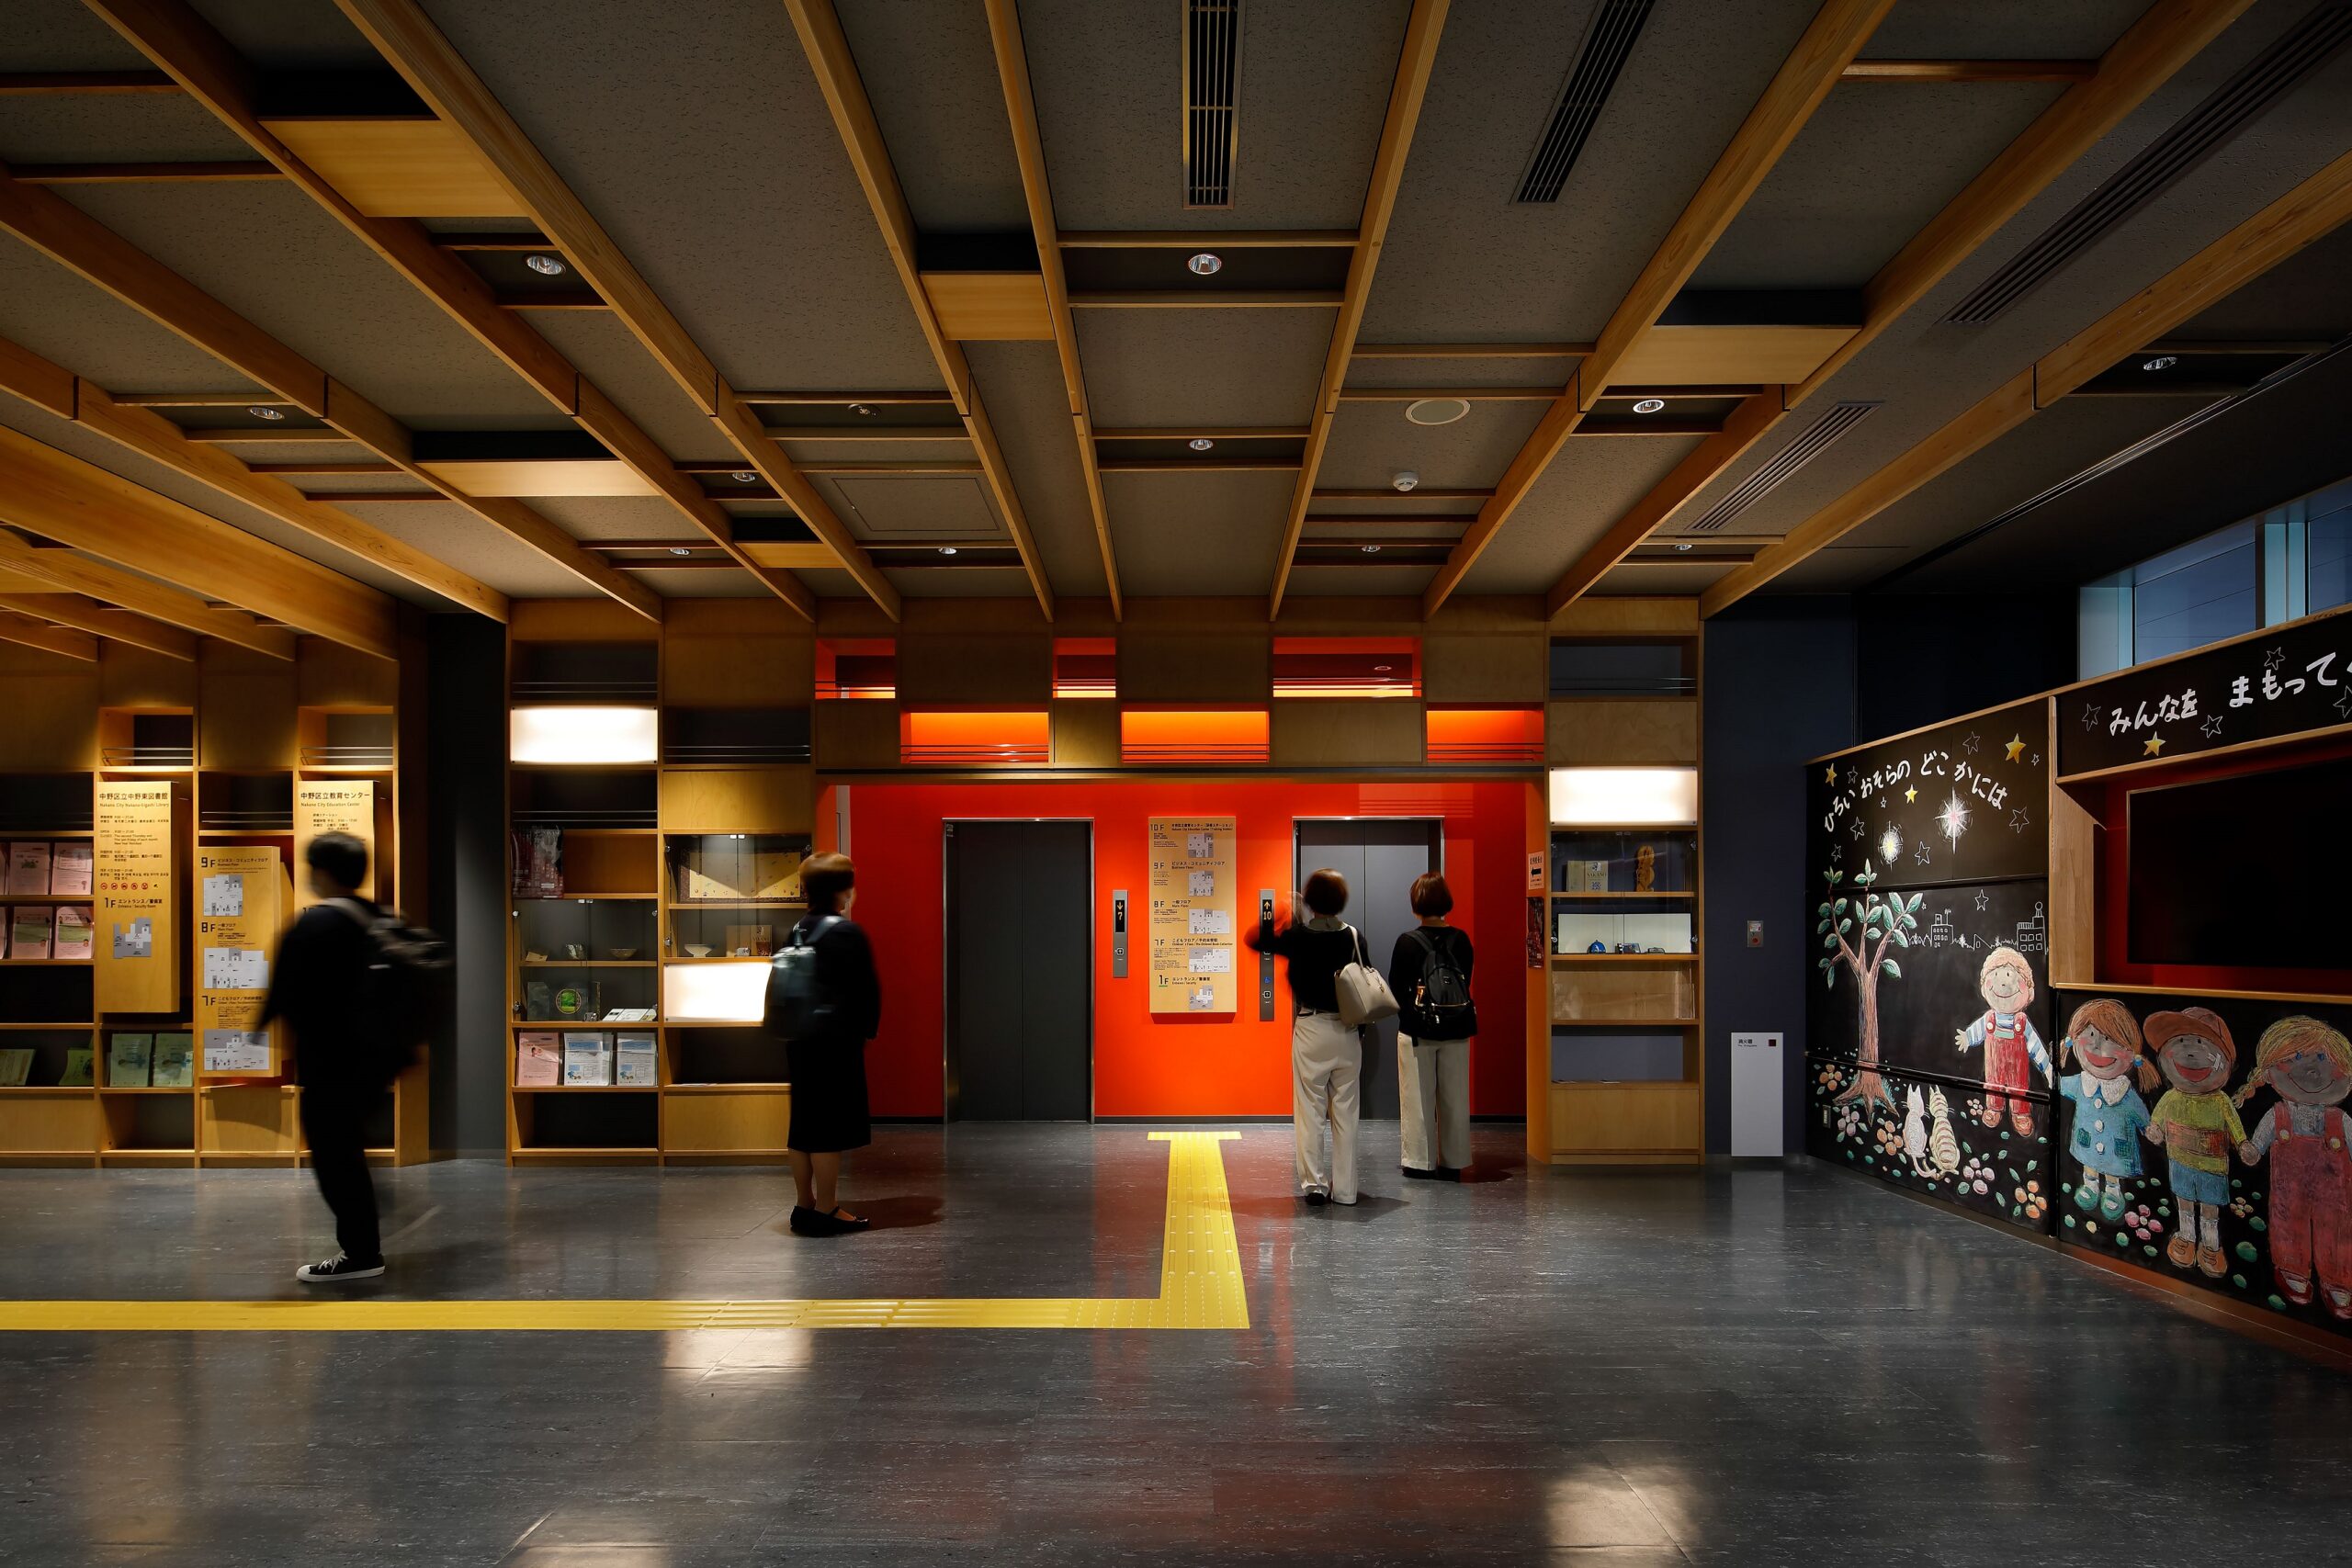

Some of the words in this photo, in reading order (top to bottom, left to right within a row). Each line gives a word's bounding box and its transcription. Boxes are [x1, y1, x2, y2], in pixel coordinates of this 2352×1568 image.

[2109, 689, 2198, 737] みんなを
[2228, 651, 2352, 707] まもって
[99, 792, 168, 800] 中野区立中野東図書館
[1824, 789, 1856, 832] ひろい
[1860, 760, 1911, 798] おそらの
[1920, 750, 1950, 776] どこ
[1953, 761, 2007, 810] かには
[1150, 823, 1165, 831] 10F
[201, 856, 216, 868] 9F
[105, 897, 117, 908] 1F
[1263, 910, 1272, 920] 10
[201, 921, 216, 932] 8F
[1159, 975, 1169, 985] 1F
[201, 995, 216, 1006] 7F
